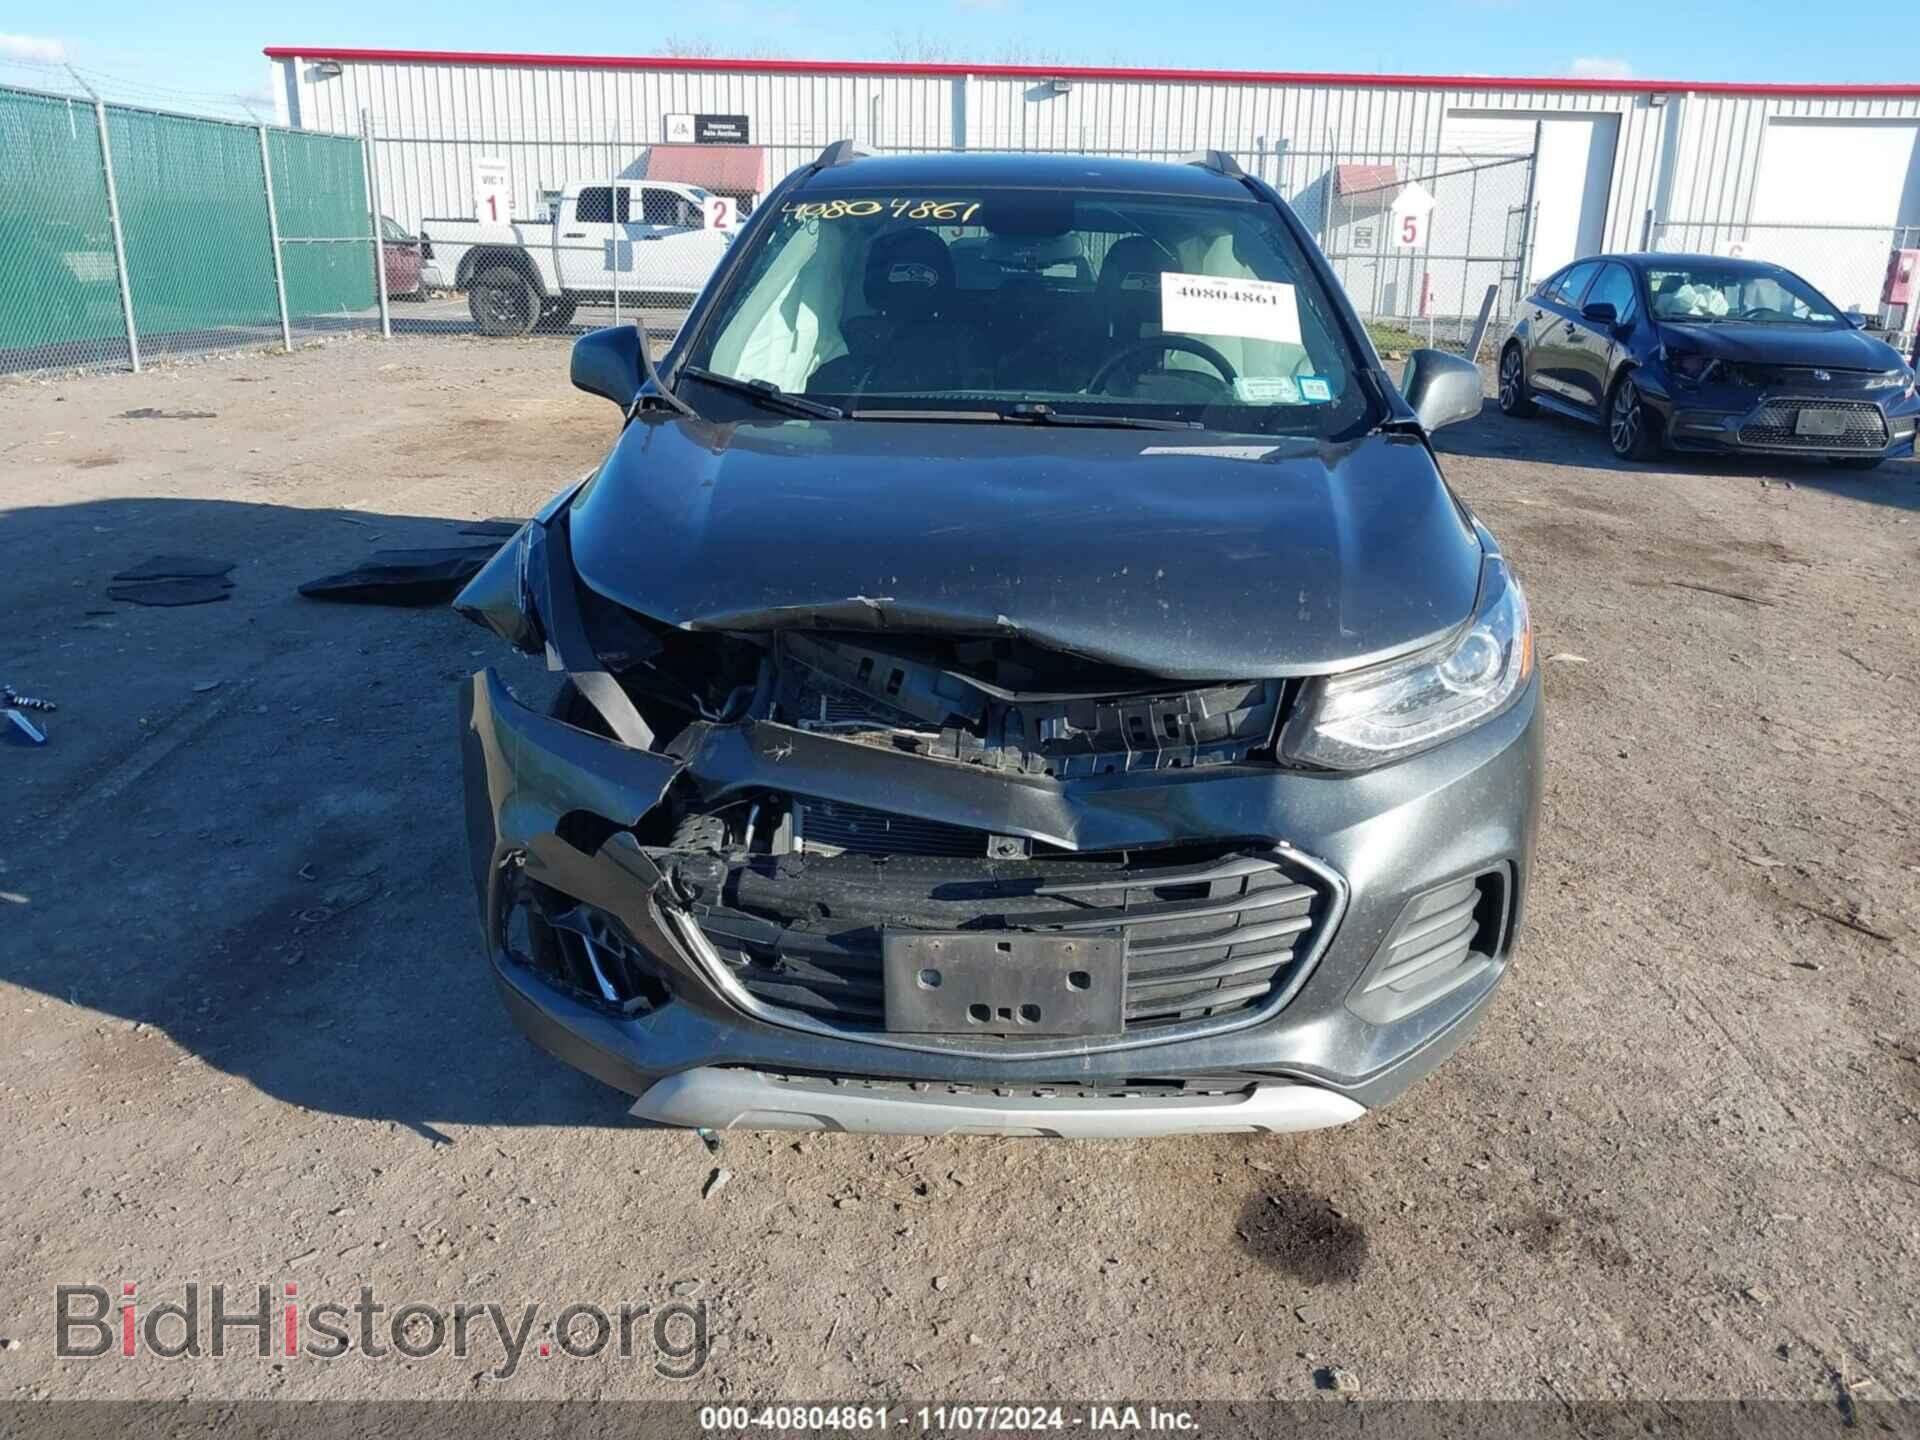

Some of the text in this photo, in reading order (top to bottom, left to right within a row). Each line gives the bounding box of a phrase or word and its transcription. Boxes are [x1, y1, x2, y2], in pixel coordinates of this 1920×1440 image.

[485, 194, 497, 222] 1
[713, 200, 727, 229] 2
[1402, 215, 1417, 244] 5
[1176, 286, 1278, 306] 40804861
